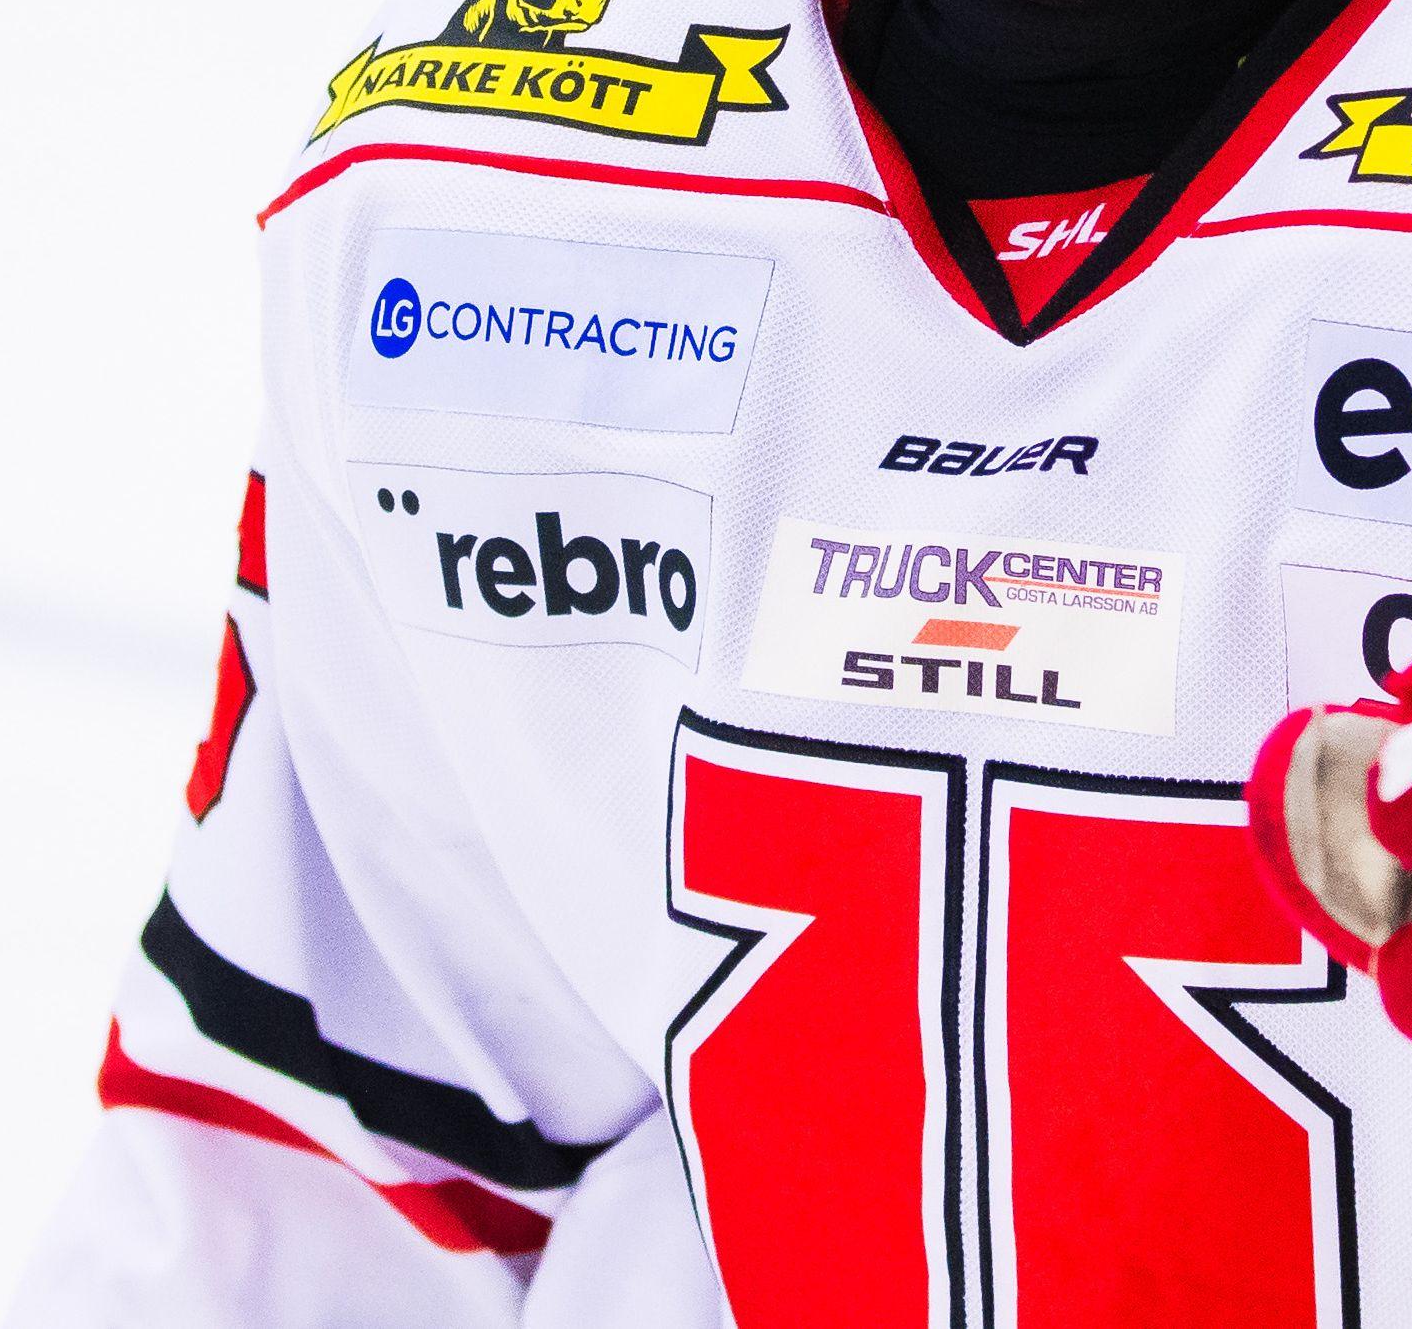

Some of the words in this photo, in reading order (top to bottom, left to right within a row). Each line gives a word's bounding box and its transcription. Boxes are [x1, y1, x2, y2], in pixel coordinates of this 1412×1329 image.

[355, 53, 506, 102] NÄRKE
[511, 60, 653, 116] KÖTT
[996, 203, 1108, 261] SHL
[377, 294, 417, 338] LG
[426, 300, 737, 362] CONTRACTING
[811, 537, 1003, 608] TRUCK
[1003, 553, 1163, 592] CENTER
[1063, 593, 1137, 613] LARSSON
[1139, 602, 1159, 616] AB
[841, 650, 1082, 710] STILL
